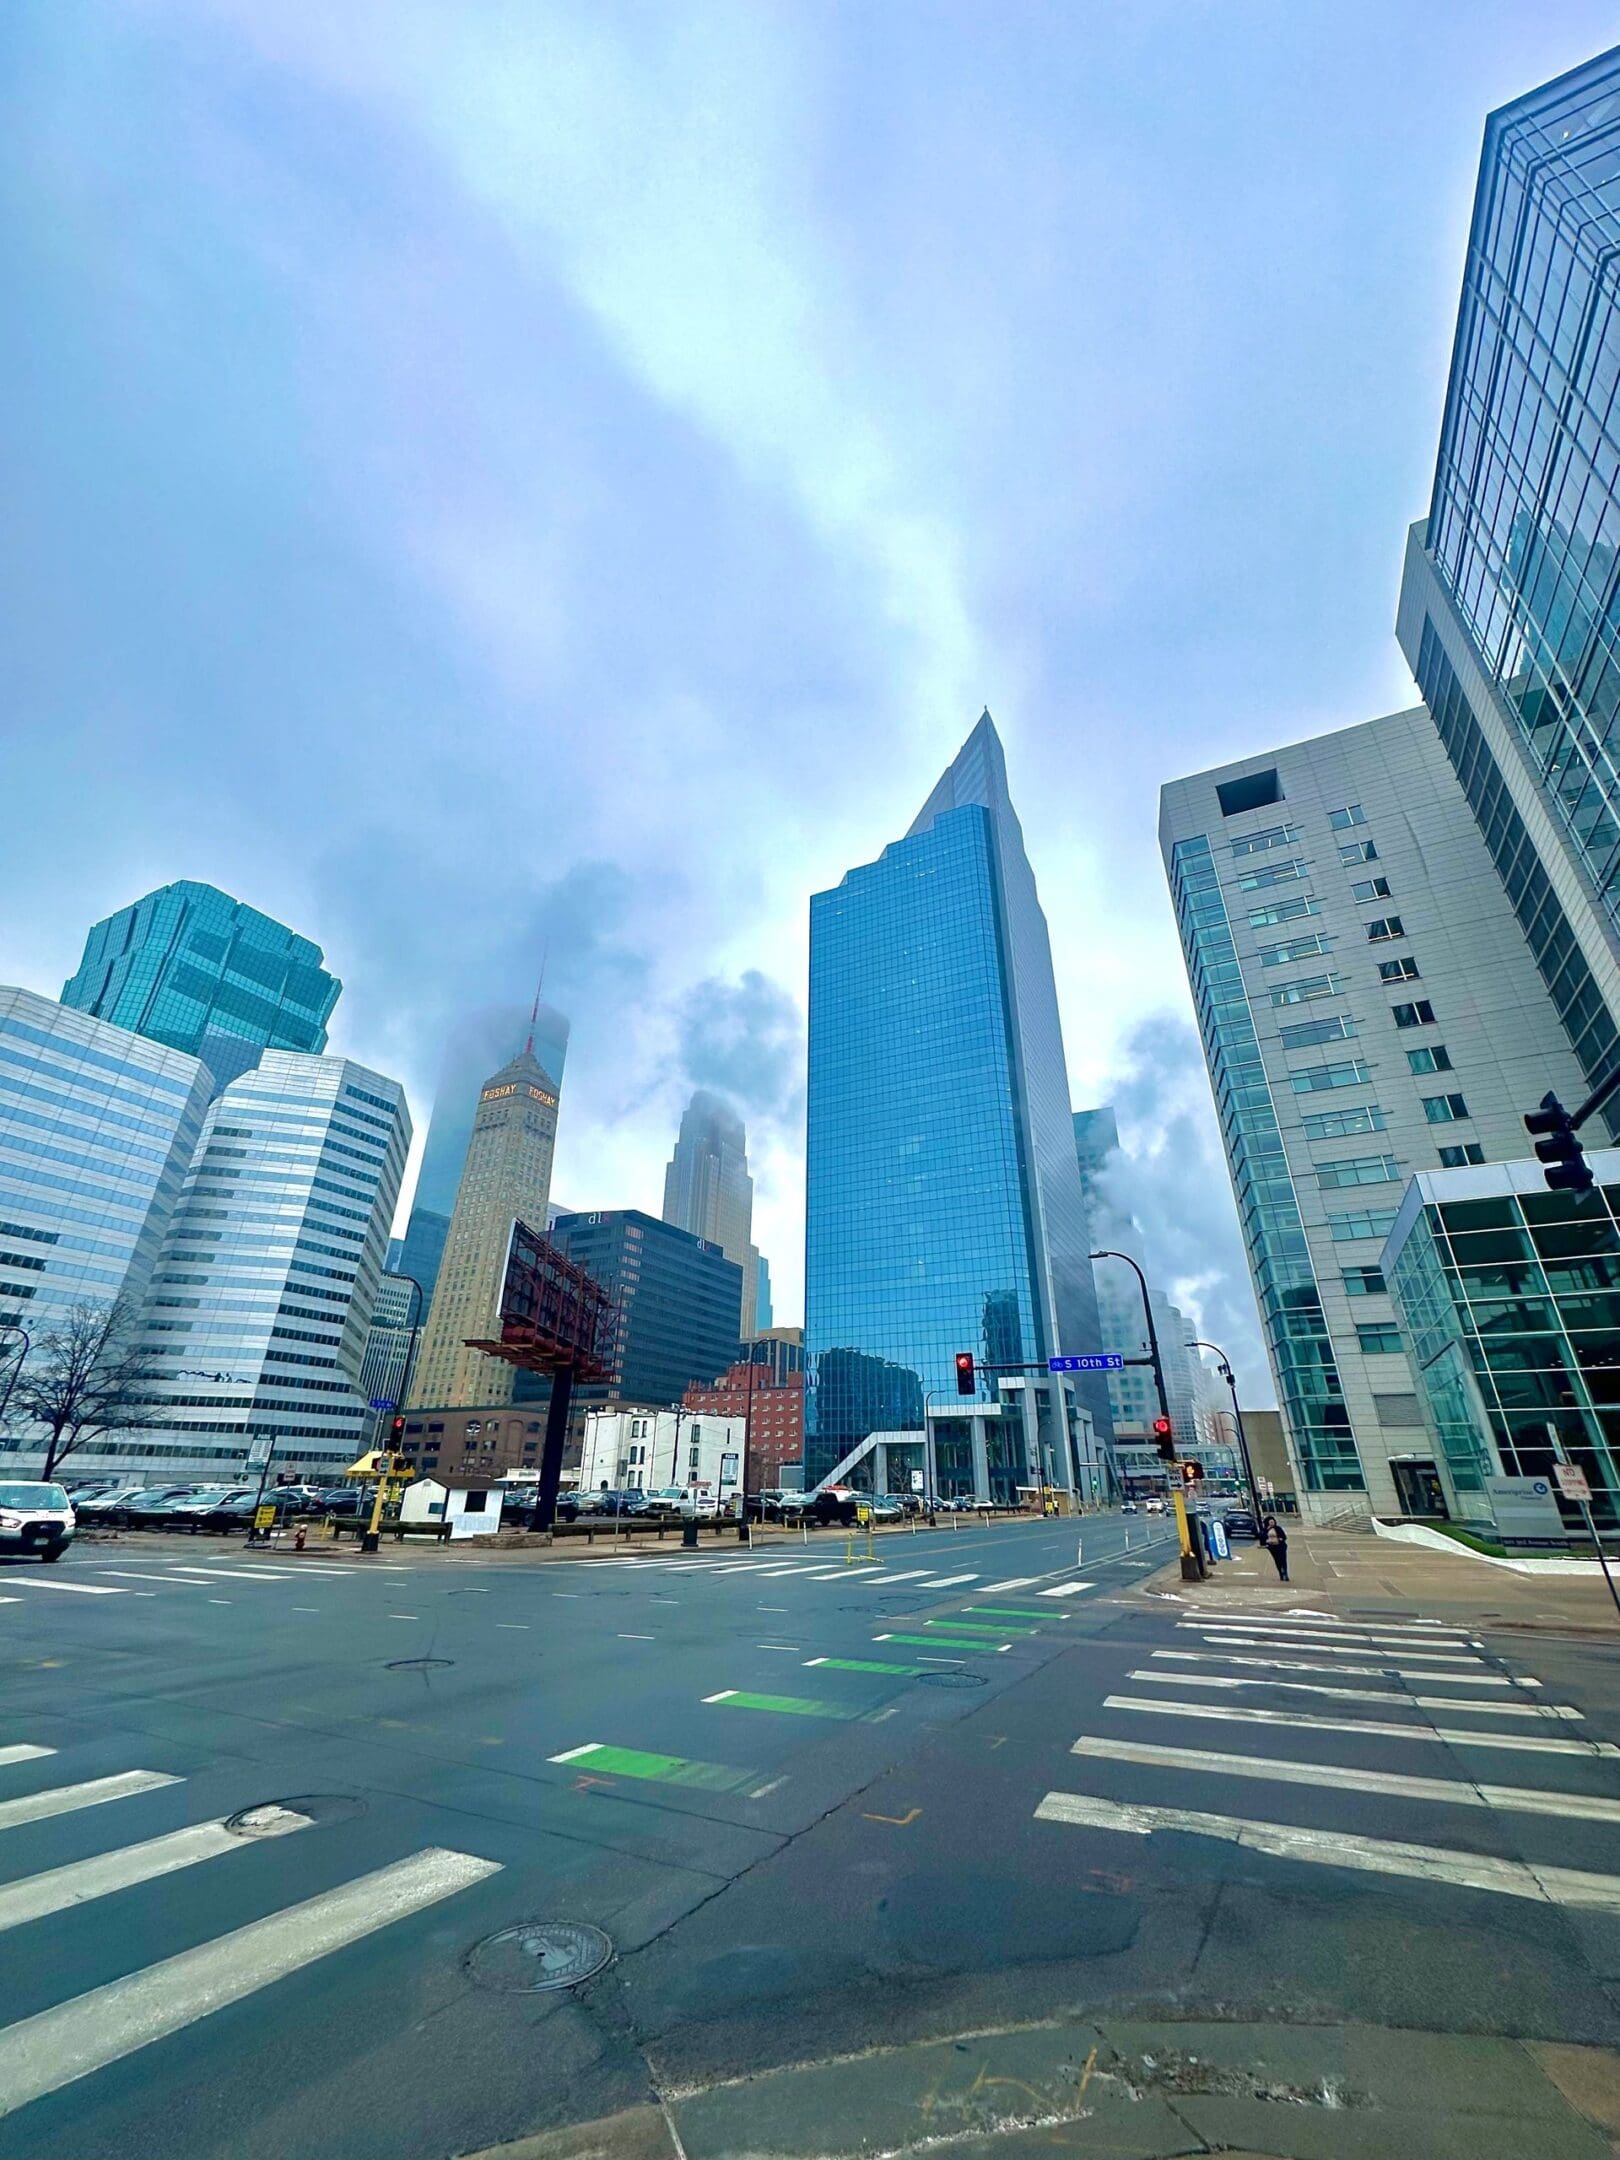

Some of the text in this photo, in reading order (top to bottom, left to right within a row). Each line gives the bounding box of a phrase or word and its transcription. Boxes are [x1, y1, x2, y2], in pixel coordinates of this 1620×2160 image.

[484, 1084, 517, 1101] FOSHAY
[529, 1086, 556, 1106] FOSHAY
[1065, 1357, 1121, 1368] S 10th St
